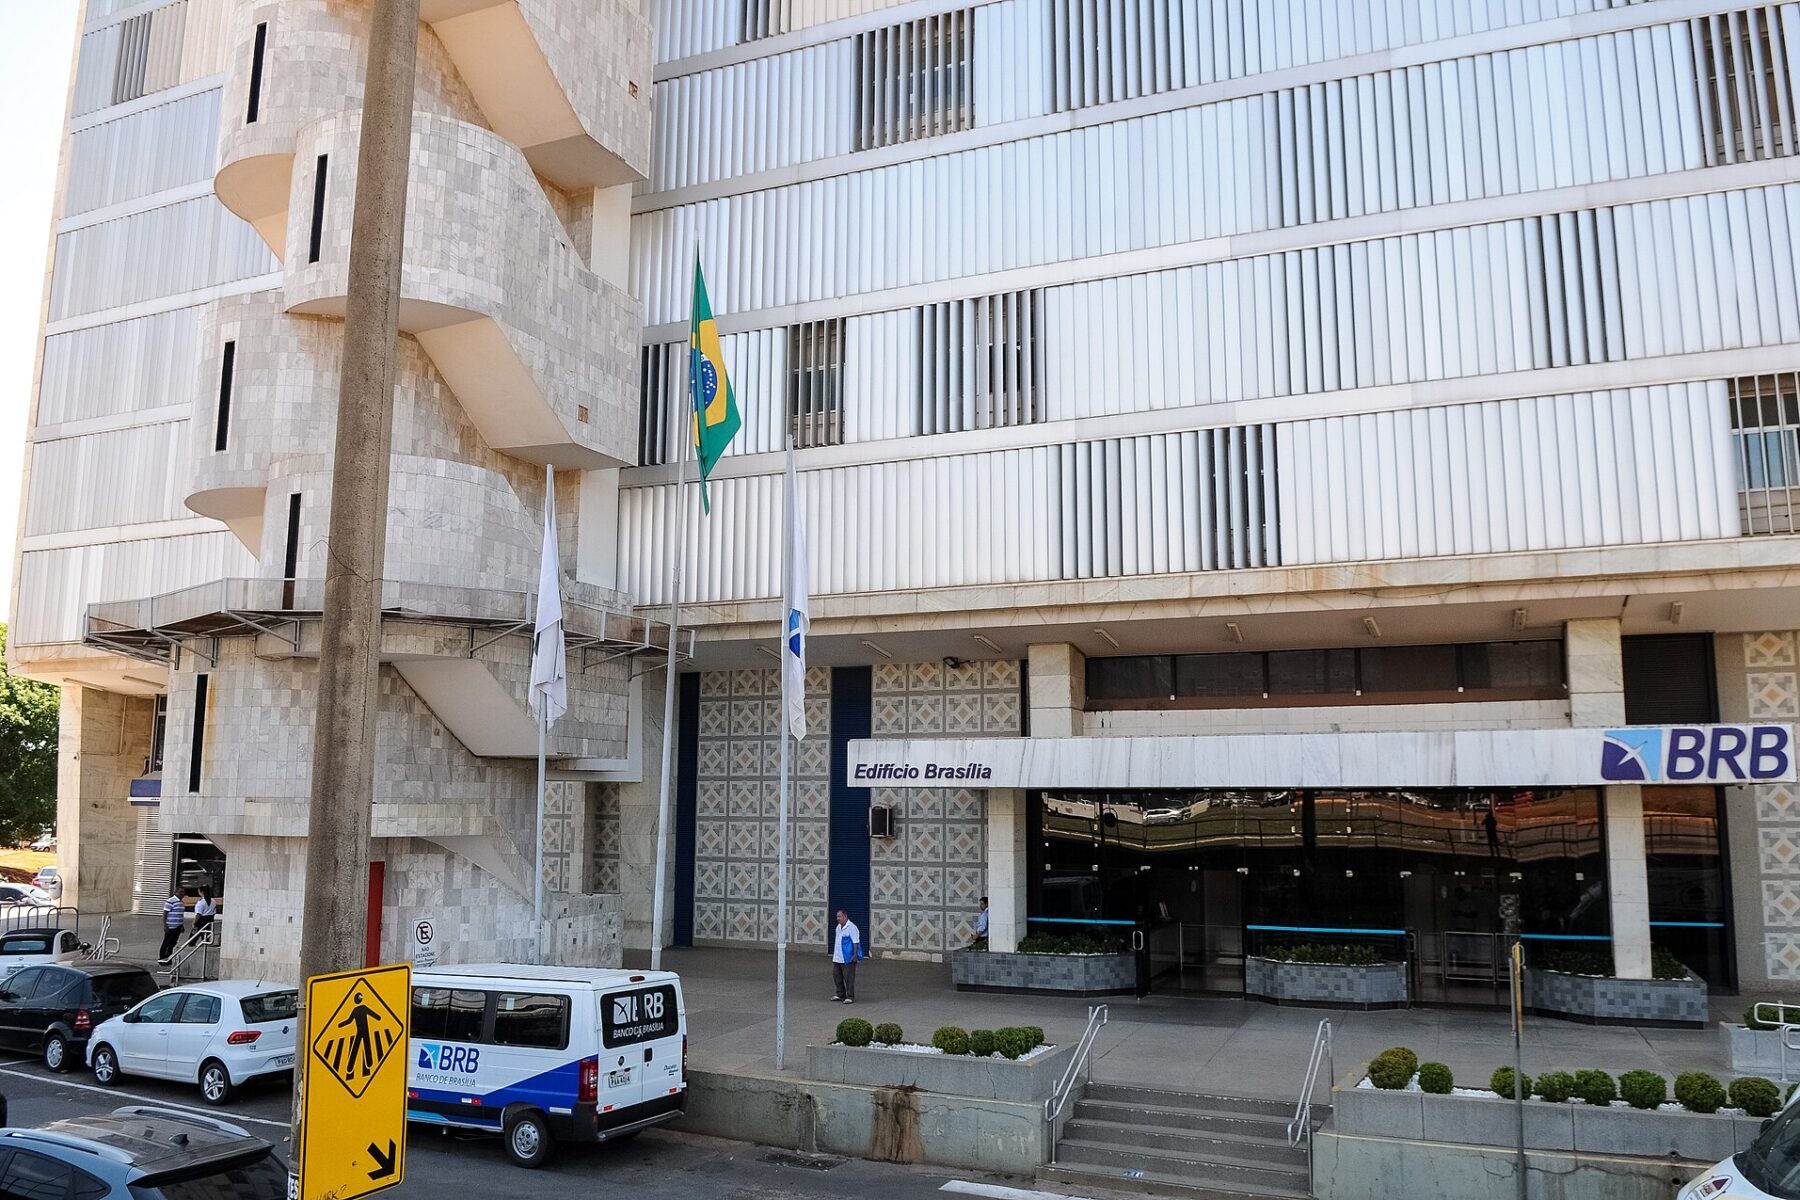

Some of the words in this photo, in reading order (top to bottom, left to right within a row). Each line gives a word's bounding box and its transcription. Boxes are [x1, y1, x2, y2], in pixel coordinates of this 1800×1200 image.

[1667, 726, 1788, 780] BRB
[854, 763, 919, 779] Edifício
[924, 763, 992, 779] Brasília
[439, 1045, 480, 1074] BRB
[416, 1072, 439, 1084] BANCO
[440, 1075, 448, 1085] DE
